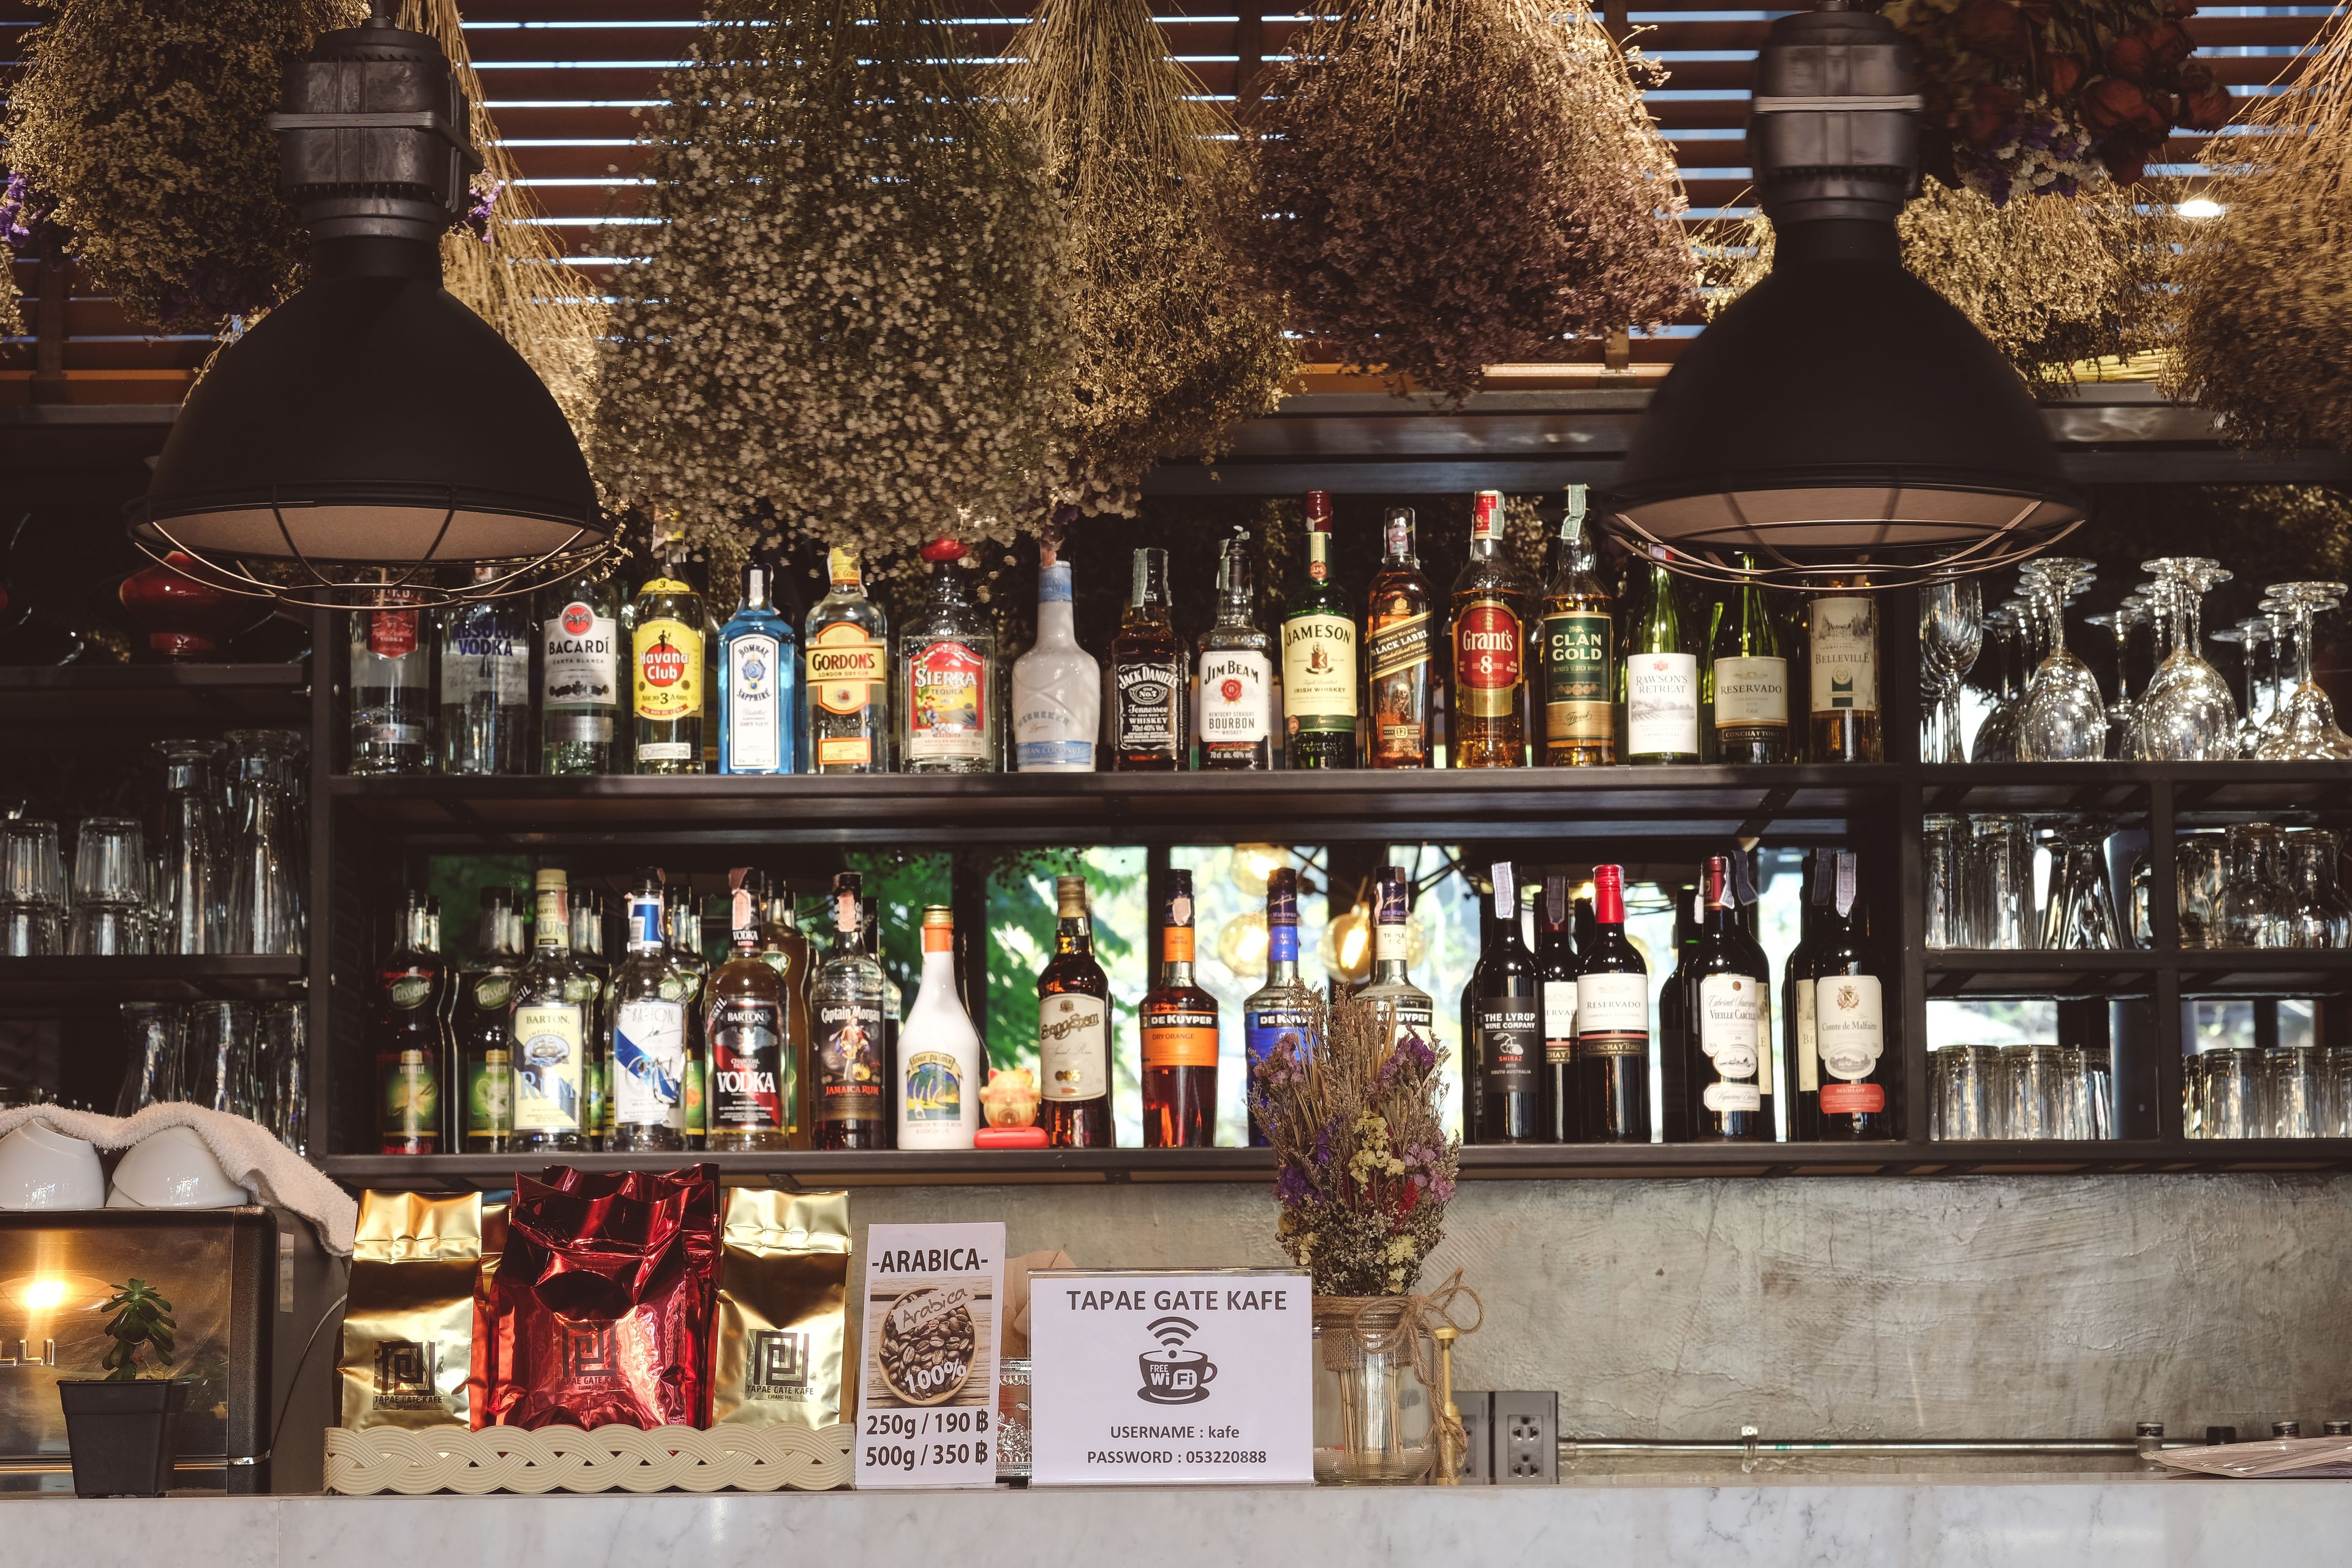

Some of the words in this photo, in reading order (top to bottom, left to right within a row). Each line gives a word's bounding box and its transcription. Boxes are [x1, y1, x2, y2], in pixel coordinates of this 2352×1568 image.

[1476, 514, 1483, 528] 8
[1286, 625, 1351, 647] JAMESON
[1370, 640, 1400, 656] BLACK
[1400, 630, 1429, 646] LABEL
[1463, 629, 1513, 652] Grant's
[1551, 633, 1602, 647] CLAN
[458, 639, 513, 657] VODKA
[549, 637, 610, 655] BACARDÍ
[738, 644, 770, 658] BOMBAY
[639, 652, 689, 665] Havana
[812, 653, 875, 671] GORDON'S
[1552, 648, 1602, 662] GOLD
[1815, 652, 1869, 664] BELLEVILLE
[1480, 655, 1493, 674] 8
[647, 665, 678, 680] Club
[915, 665, 978, 688] SIERRA
[1118, 671, 1142, 690] JACK
[1142, 666, 1180, 688] DANIEL'S
[1204, 665, 1225, 685] JIM
[1228, 660, 1259, 685] BEAM
[1636, 675, 1688, 686] RAWSON'S
[737, 688, 771, 702] SAPPHIRE
[1639, 685, 1686, 694] RETREAT
[1721, 684, 1782, 695] RESERVADO
[660, 693, 669, 704] 3
[1128, 704, 1169, 714] Tennessee
[1209, 718, 1254, 729] BOURBON
[535, 918, 566, 935] RUM
[733, 930, 759, 941] VODKA
[391, 981, 431, 1003] Teisseire
[475, 980, 511, 1005] Teisseir
[526, 1015, 568, 1024] BARTON
[727, 1012, 765, 1022] BARTON
[821, 1006, 851, 1024] Captain
[850, 1005, 880, 1023] Morgan
[1152, 1016, 1166, 1025] DE
[1167, 1014, 1212, 1025] KUYPER
[1260, 1015, 1275, 1025] DE
[1387, 1013, 1430, 1023] UYPER
[1484, 1013, 1502, 1022] THE
[1506, 1012, 1536, 1022] LYRUP
[1710, 1010, 1735, 1020] VIEILLE
[1822, 1022, 1841, 1031] Comte
[1842, 1022, 1850, 1030] de
[1852, 1020, 1877, 1030] Malfaite
[716, 1071, 777, 1093] VODKA
[825, 1085, 861, 1096] JAMAICA
[862, 1085, 880, 1096] RUM
[902, 1286, 968, 1329] Arabica
[1066, 1291, 1146, 1311] TAPAE
[1154, 1291, 1218, 1311] GATE
[1227, 1291, 1287, 1311] KAFE
[905, 1357, 967, 1394] 100%
[747, 1385, 771, 1393] TAPAE
[867, 1415, 916, 1439] 250g
[936, 1412, 970, 1433] 190
[1110, 1426, 1195, 1439] USERNAME
[1209, 1425, 1240, 1438] kafe
[865, 1446, 915, 1471] 500g
[933, 1443, 970, 1465] 350
[1088, 1450, 1173, 1464] PASSWORD
[1186, 1450, 1267, 1463] 053220888
